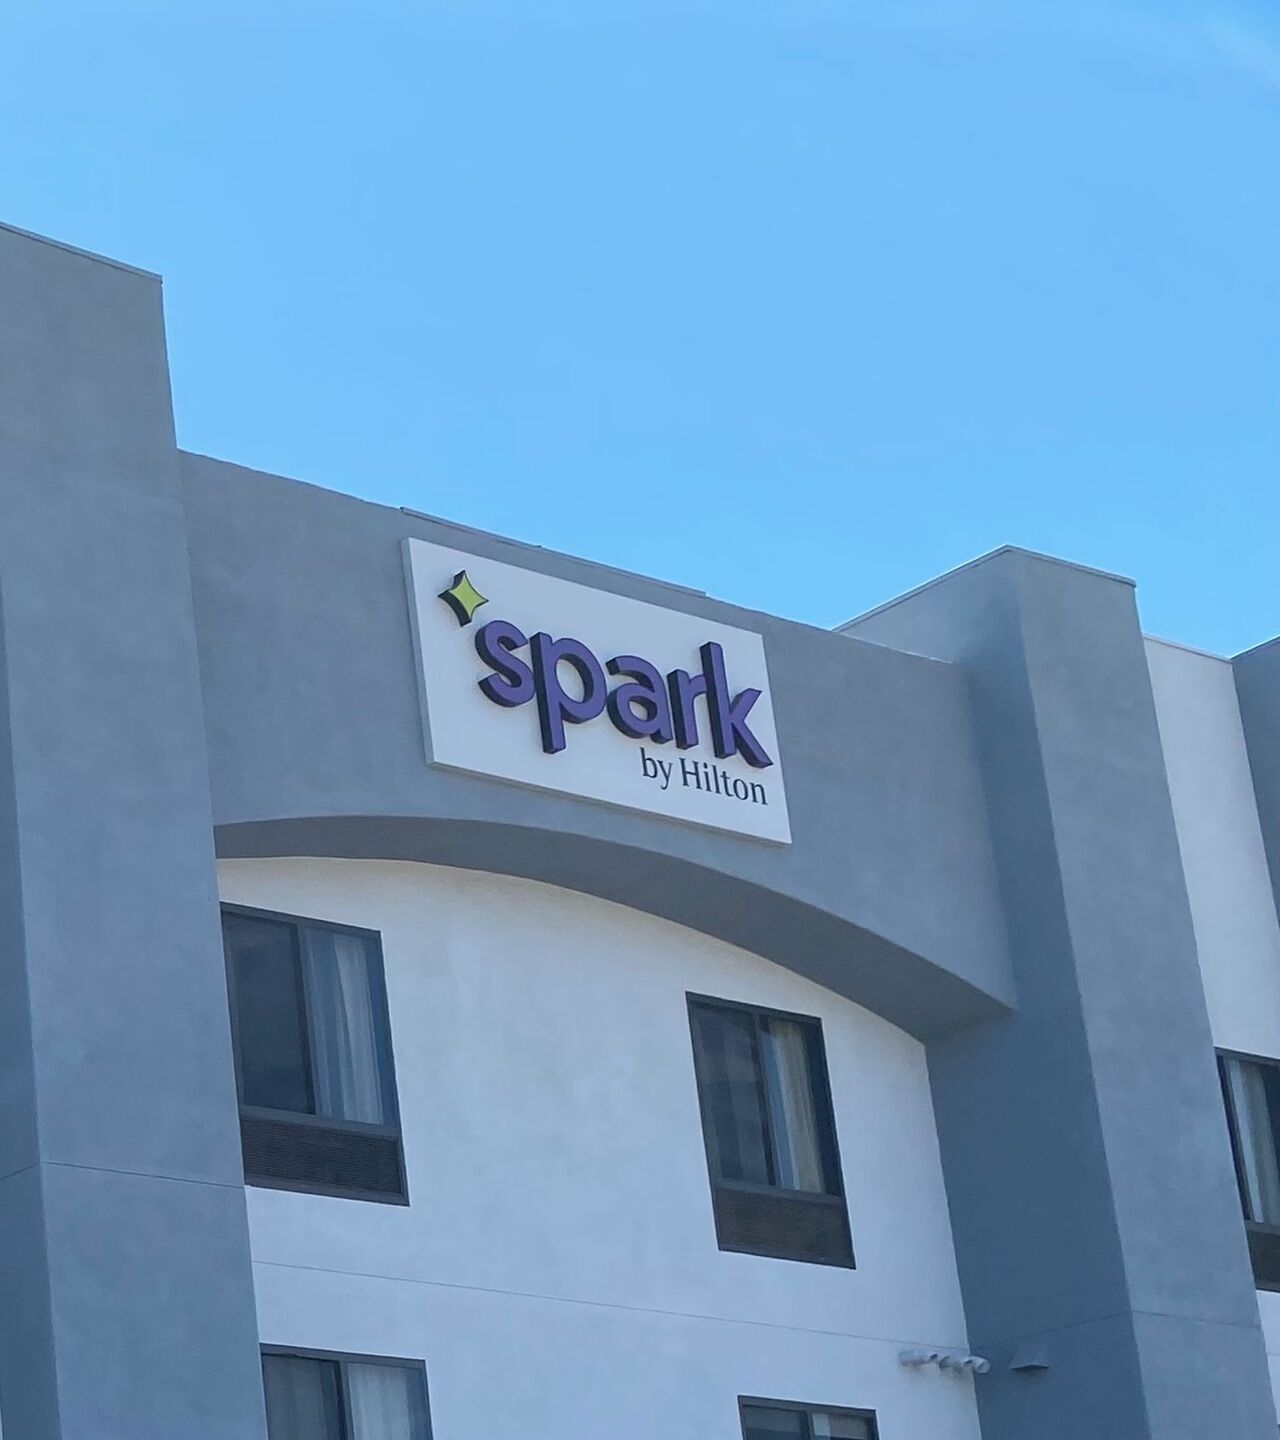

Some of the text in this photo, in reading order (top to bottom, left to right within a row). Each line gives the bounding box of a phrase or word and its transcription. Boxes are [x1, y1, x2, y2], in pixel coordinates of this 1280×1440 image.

[475, 620, 773, 768] spark
[640, 747, 768, 805] by Hilton
